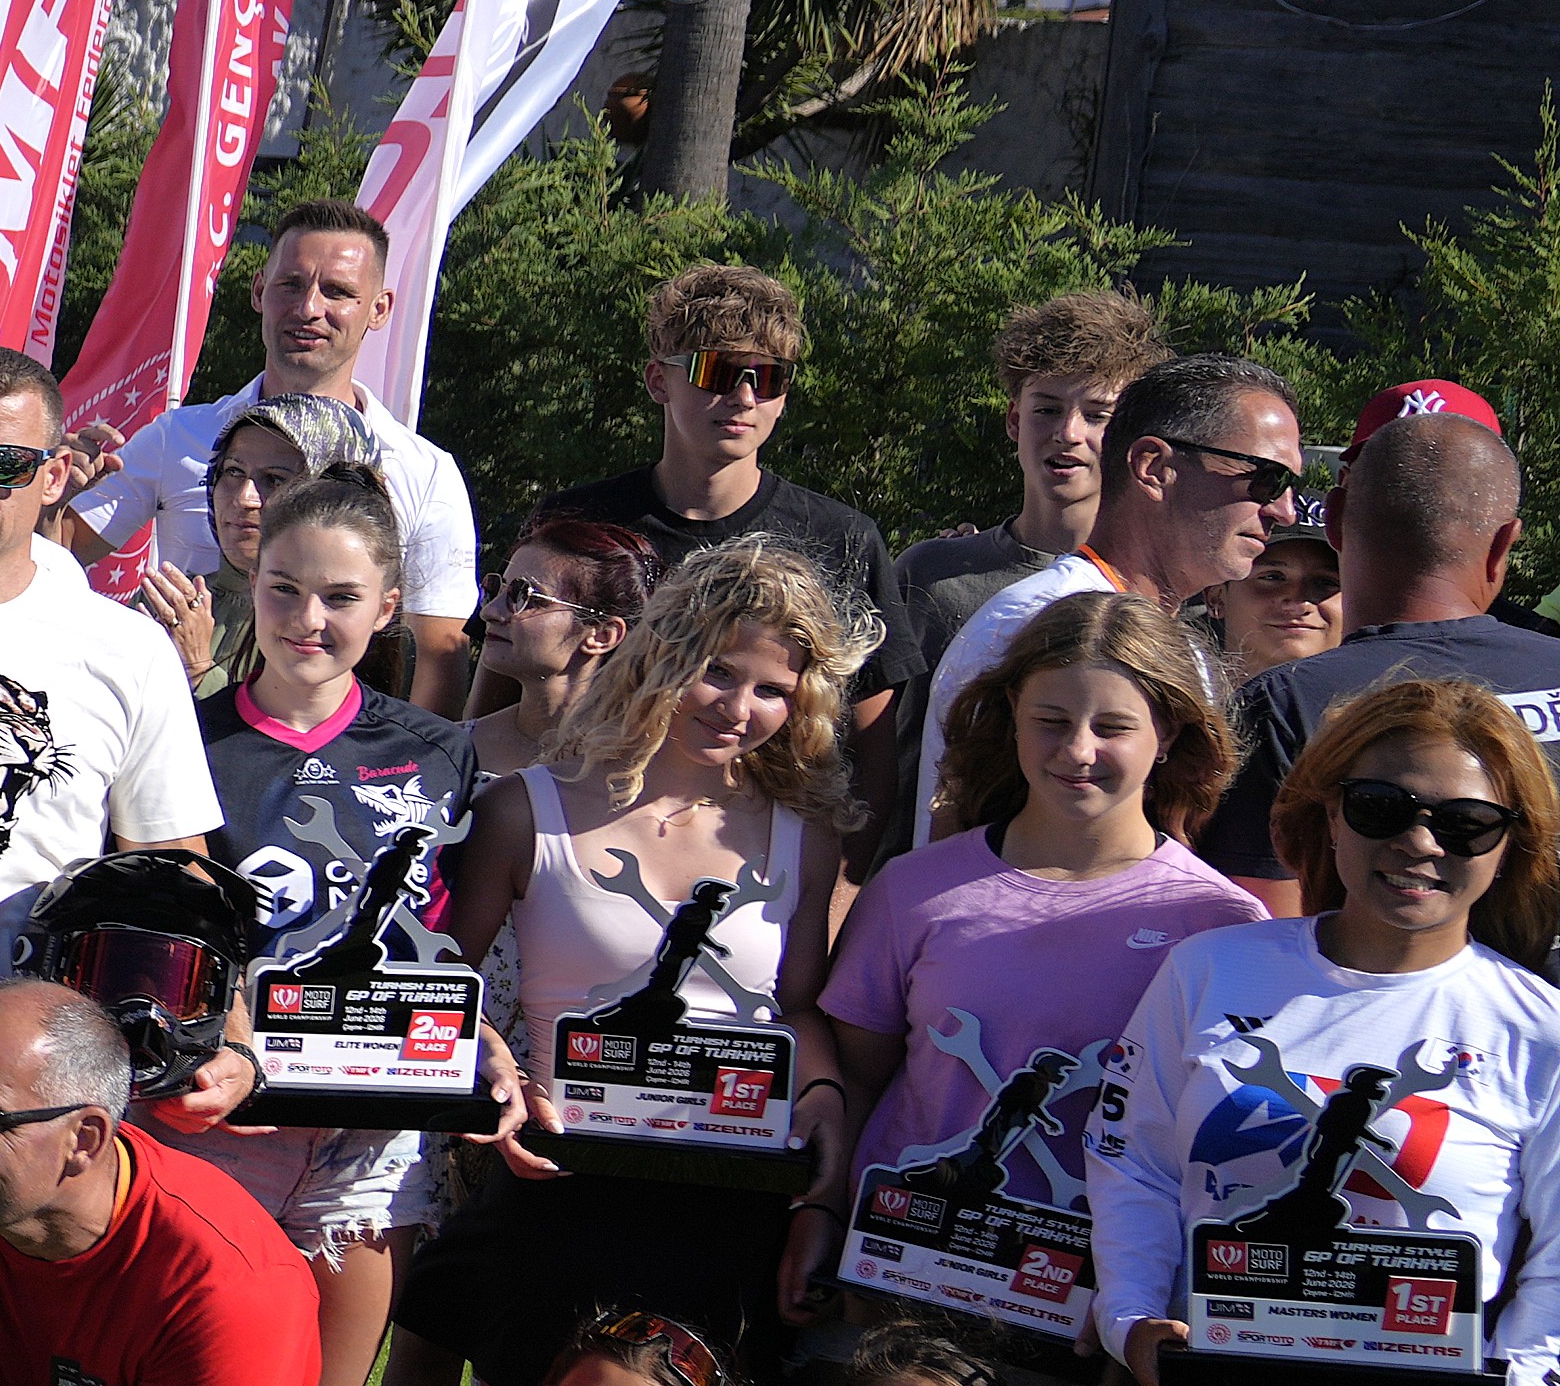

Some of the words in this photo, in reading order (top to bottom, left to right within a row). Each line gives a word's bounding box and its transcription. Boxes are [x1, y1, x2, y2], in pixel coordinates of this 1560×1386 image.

[1135, 929, 1169, 945] NIKE
[413, 1015, 459, 1043] 2ND
[413, 1042, 448, 1053] PLACE
[720, 1073, 766, 1101] 1ST
[721, 1100, 757, 1111] PLACE
[1019, 1250, 1075, 1284] 2ND
[1022, 1276, 1060, 1296] PLACE
[1390, 1282, 1448, 1313] 1ST
[1268, 1304, 1329, 1321] MASTERS
[1329, 1309, 1378, 1324] WOMEN
[1395, 1312, 1438, 1327] PLACE
